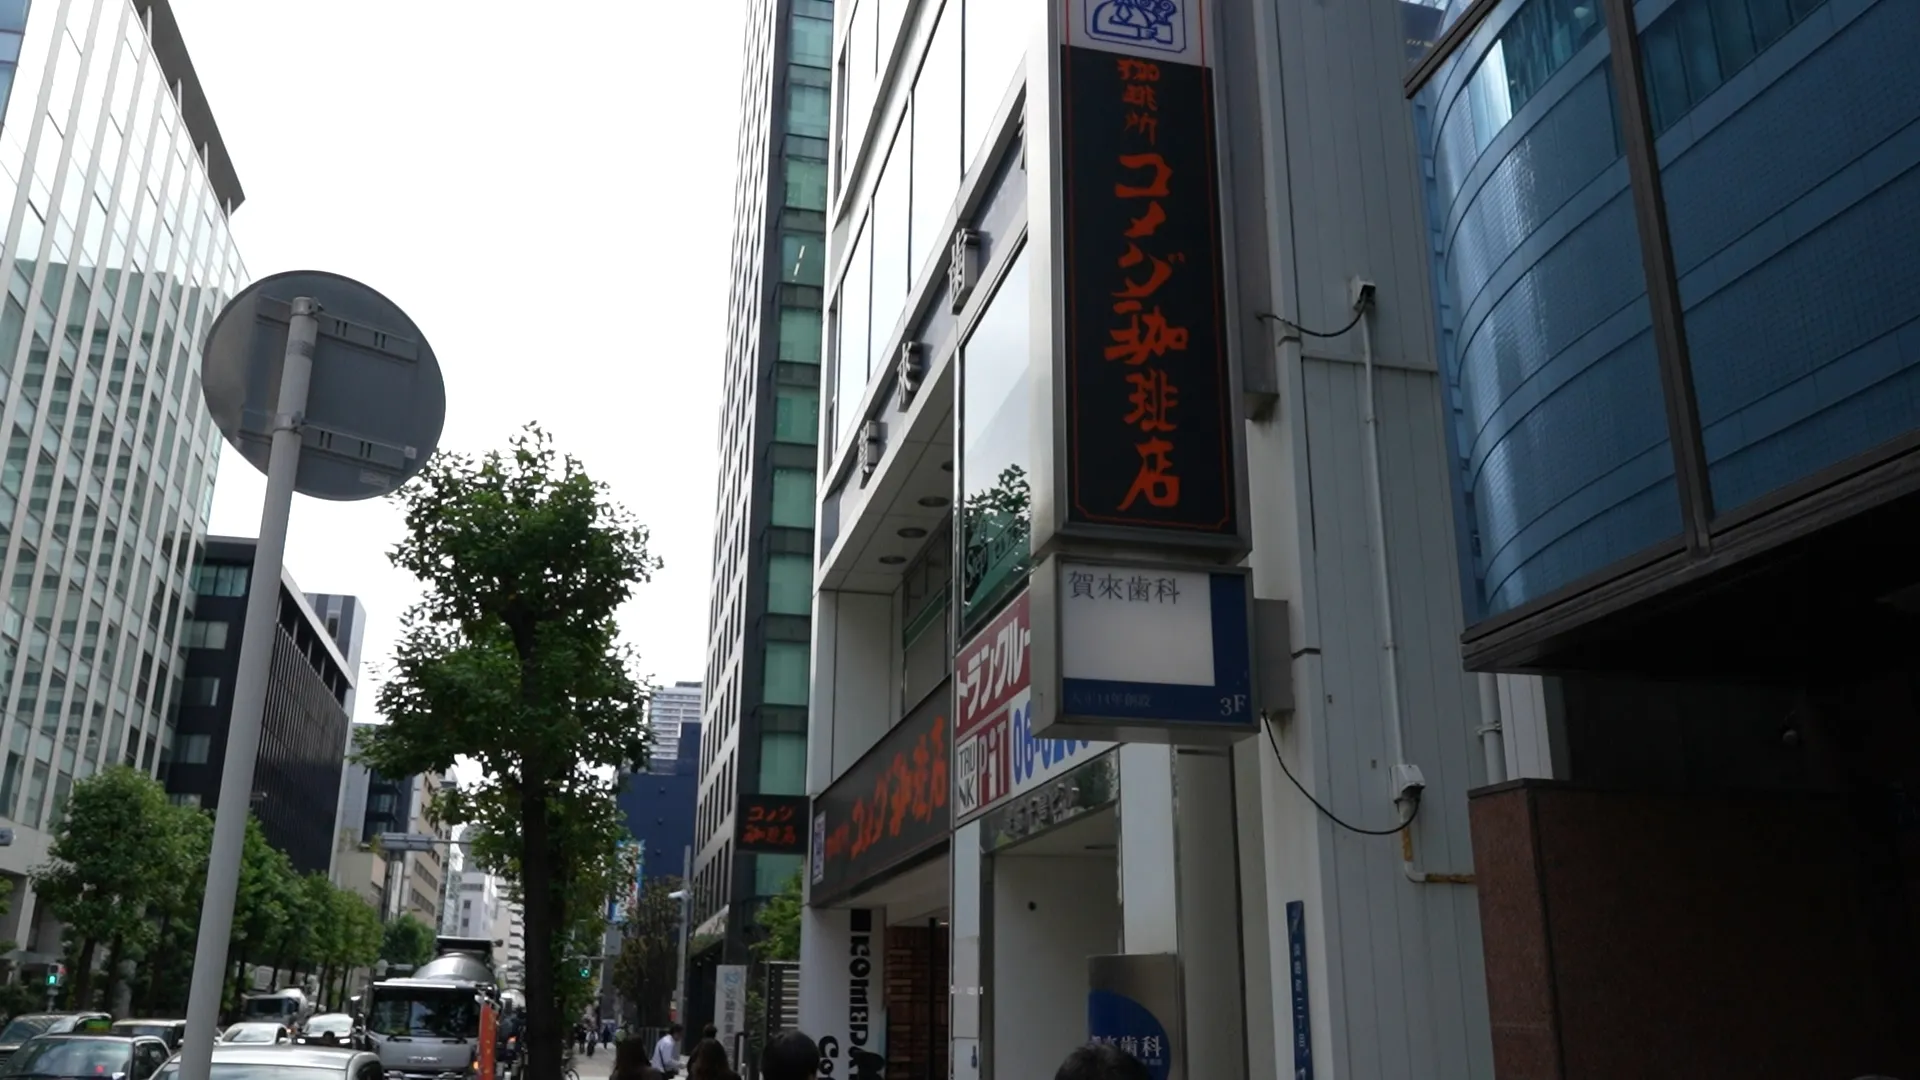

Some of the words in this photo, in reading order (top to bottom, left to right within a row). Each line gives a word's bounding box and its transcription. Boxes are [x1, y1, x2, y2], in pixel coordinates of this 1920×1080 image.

[1068, 570, 1181, 605] 賀來歯科
[1220, 694, 1247, 716] 3F
